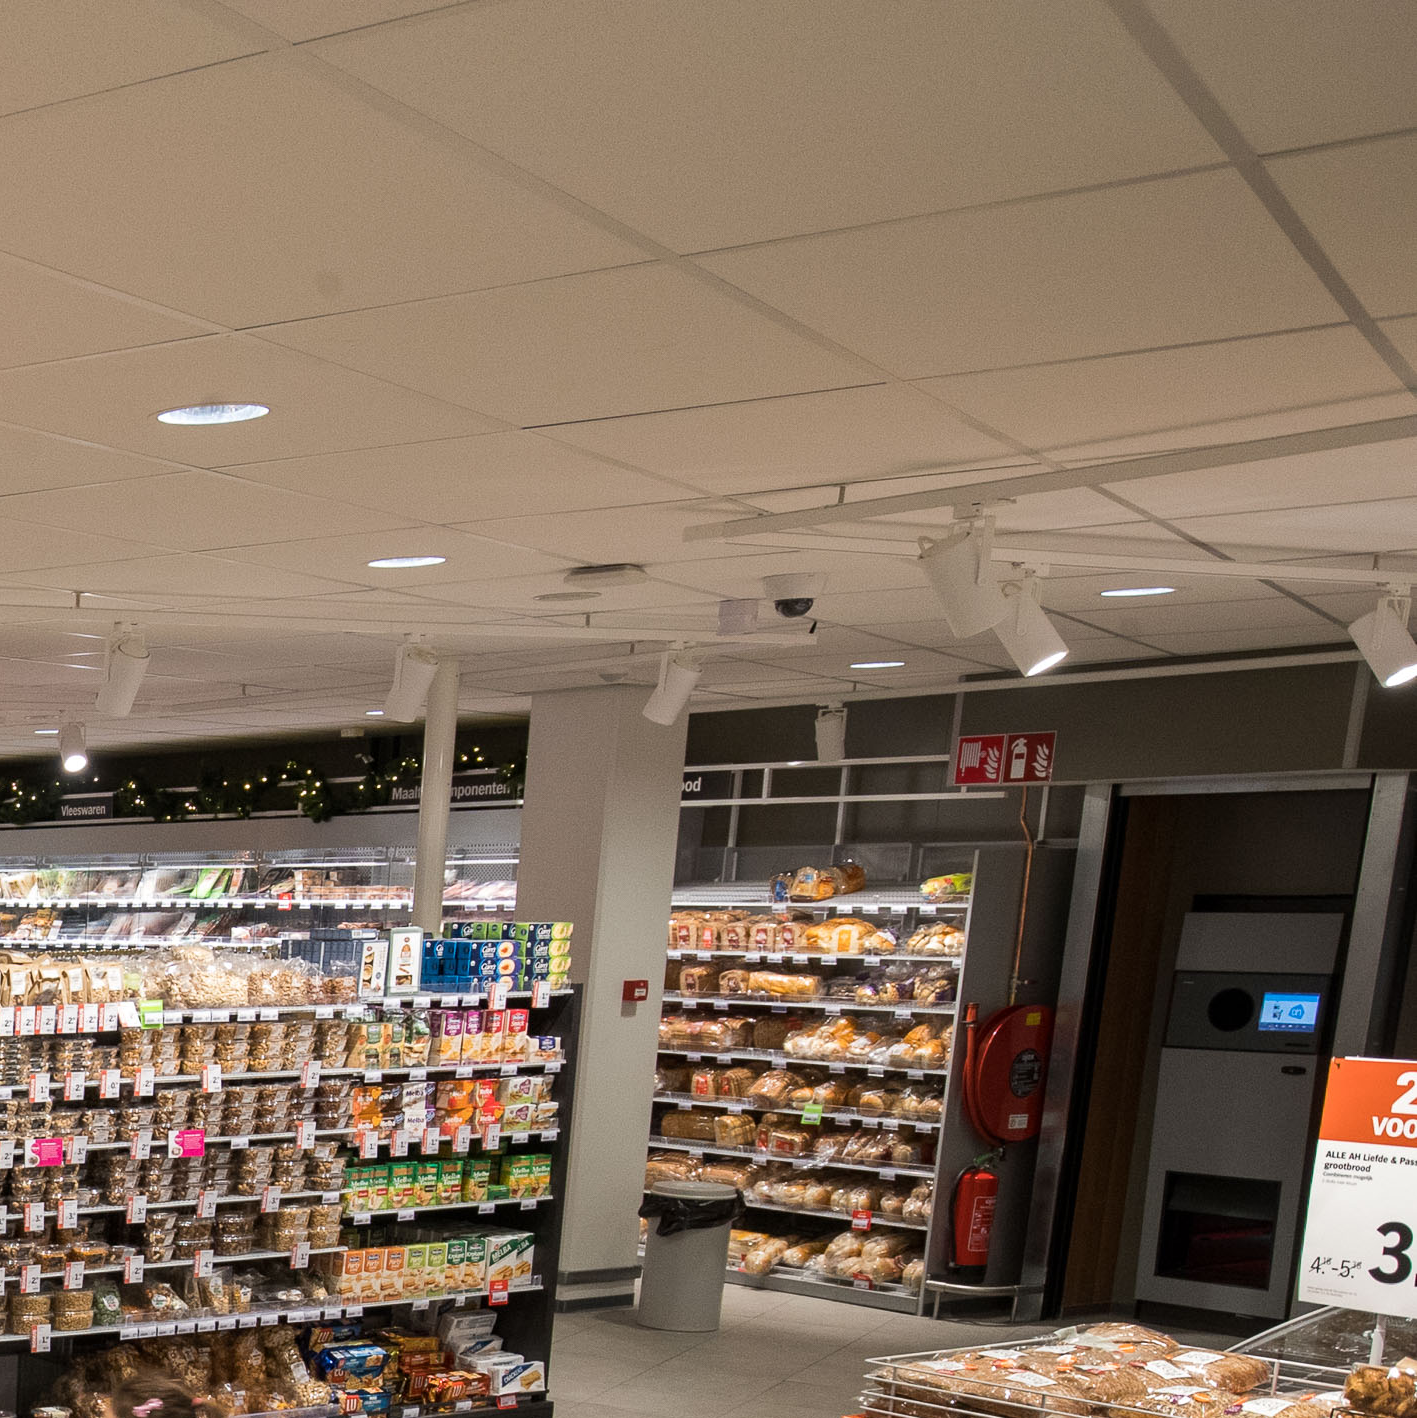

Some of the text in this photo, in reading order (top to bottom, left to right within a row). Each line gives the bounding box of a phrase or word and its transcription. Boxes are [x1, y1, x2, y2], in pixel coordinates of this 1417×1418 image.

[61, 804, 106, 817] Vleeswaren
[1325, 1150, 1417, 1166] ALLE AH Liefde & Pass
[1324, 1161, 1372, 1174] grootbrood
[490, 1242, 512, 1262] MELBA
[347, 1398, 358, 1413] LU
